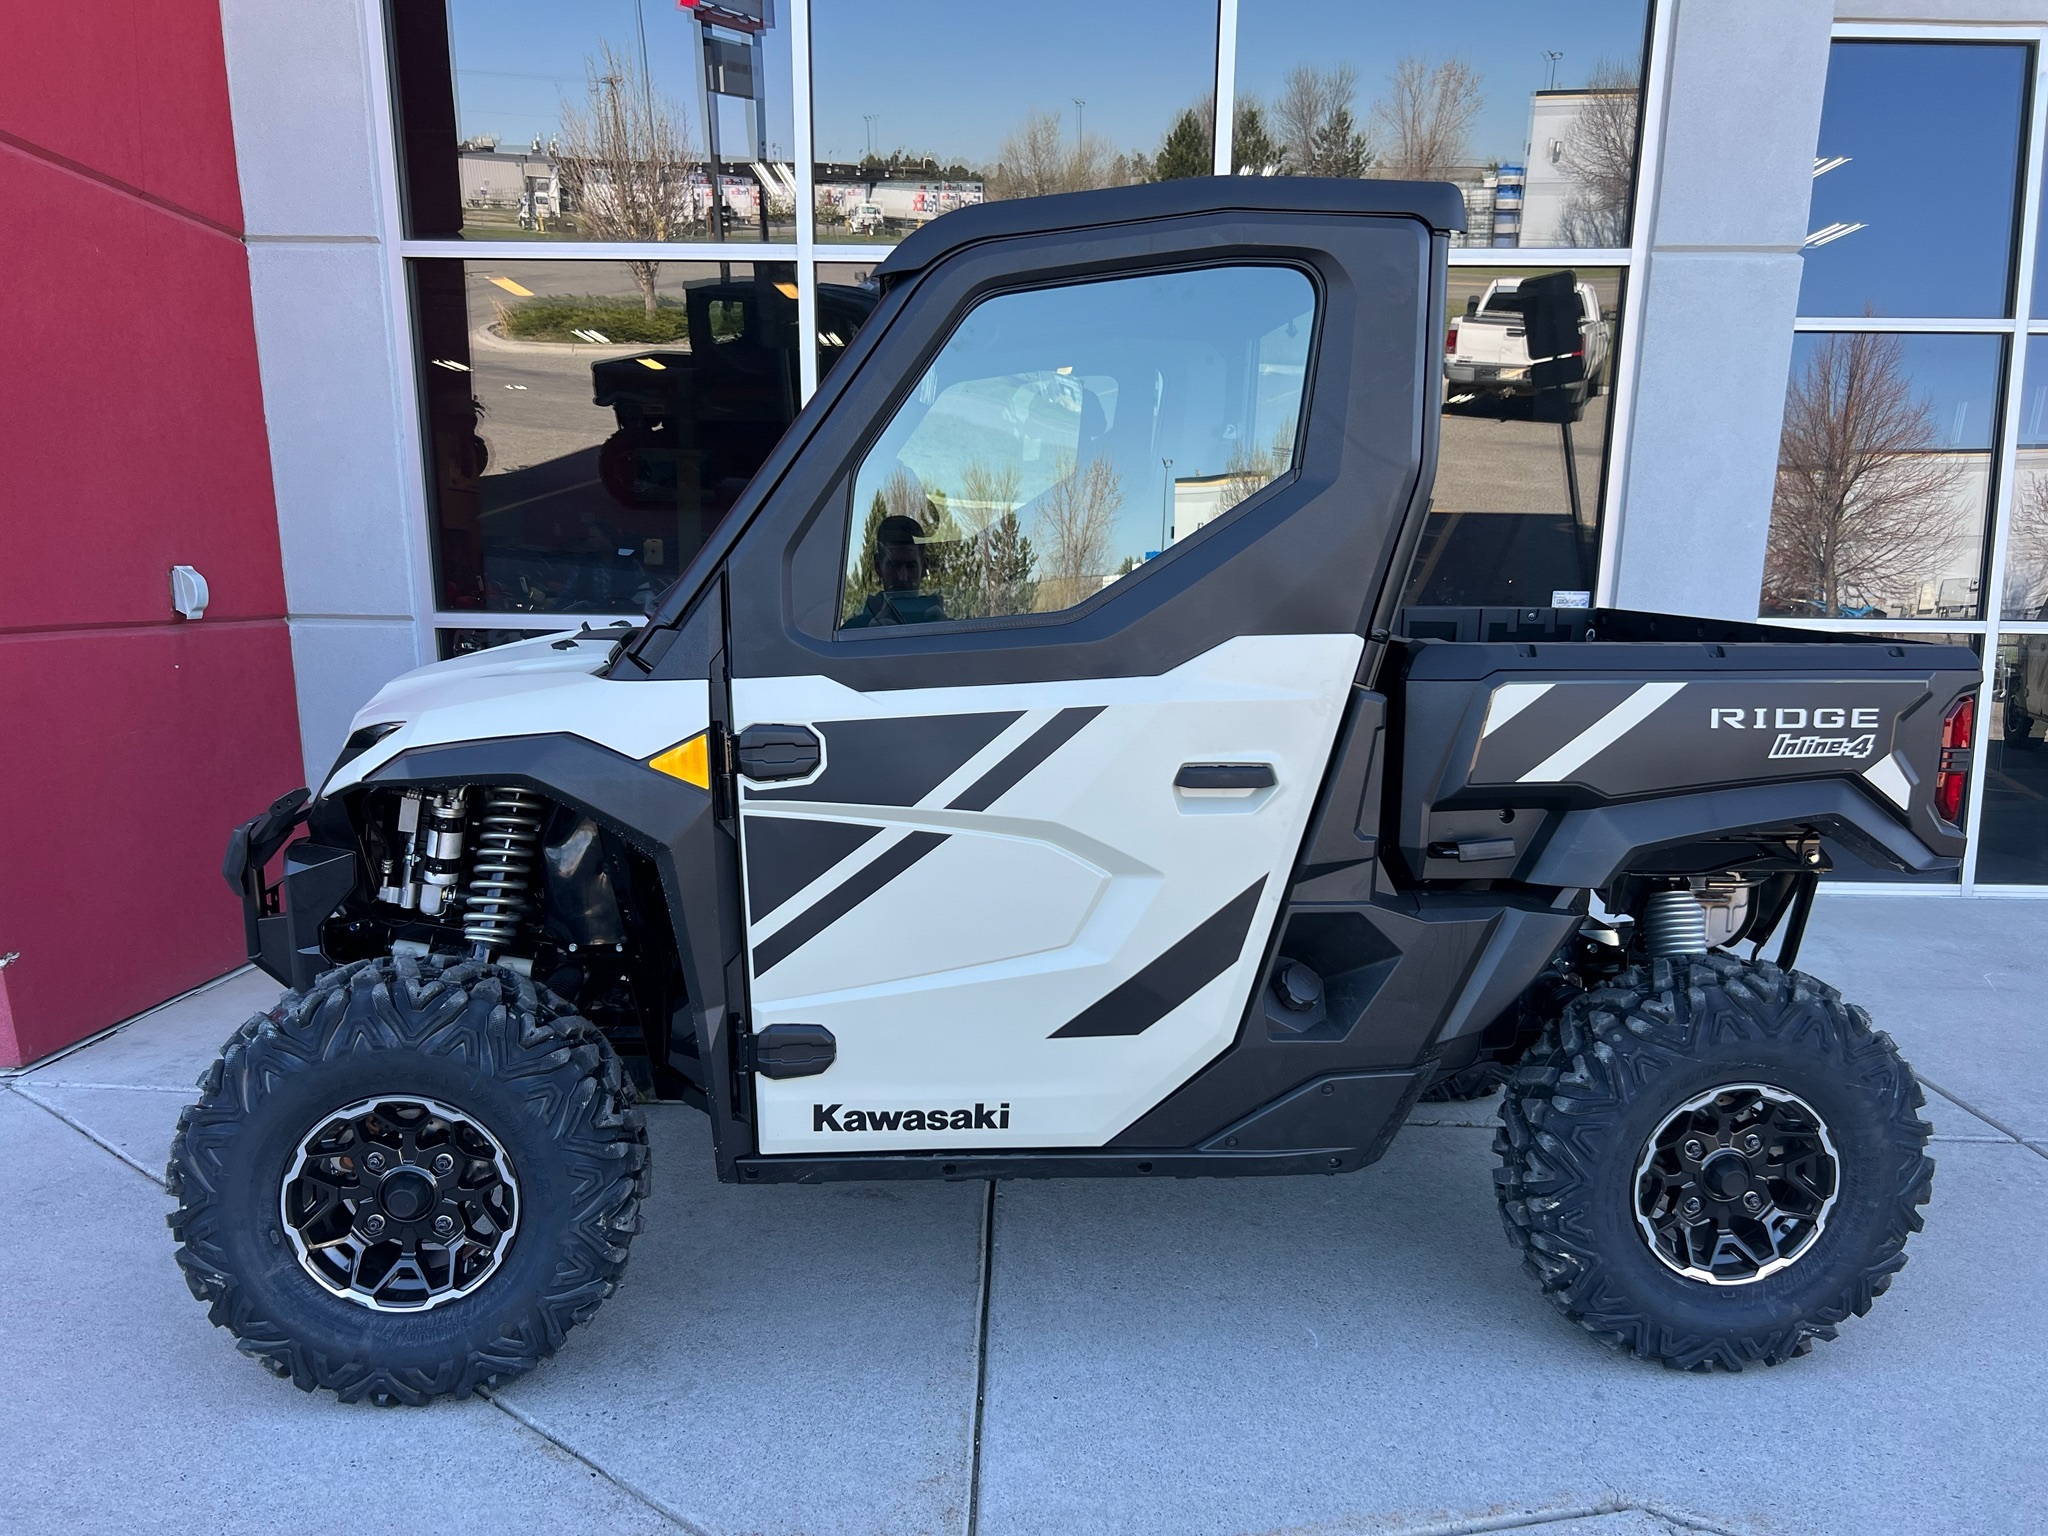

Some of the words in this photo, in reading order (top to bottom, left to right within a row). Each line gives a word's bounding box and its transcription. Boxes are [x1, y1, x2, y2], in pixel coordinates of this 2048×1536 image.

[1710, 708, 1879, 729] RIDGE
[1768, 733, 1876, 759] Inline-4
[813, 1102, 1010, 1132] Kawasaki
